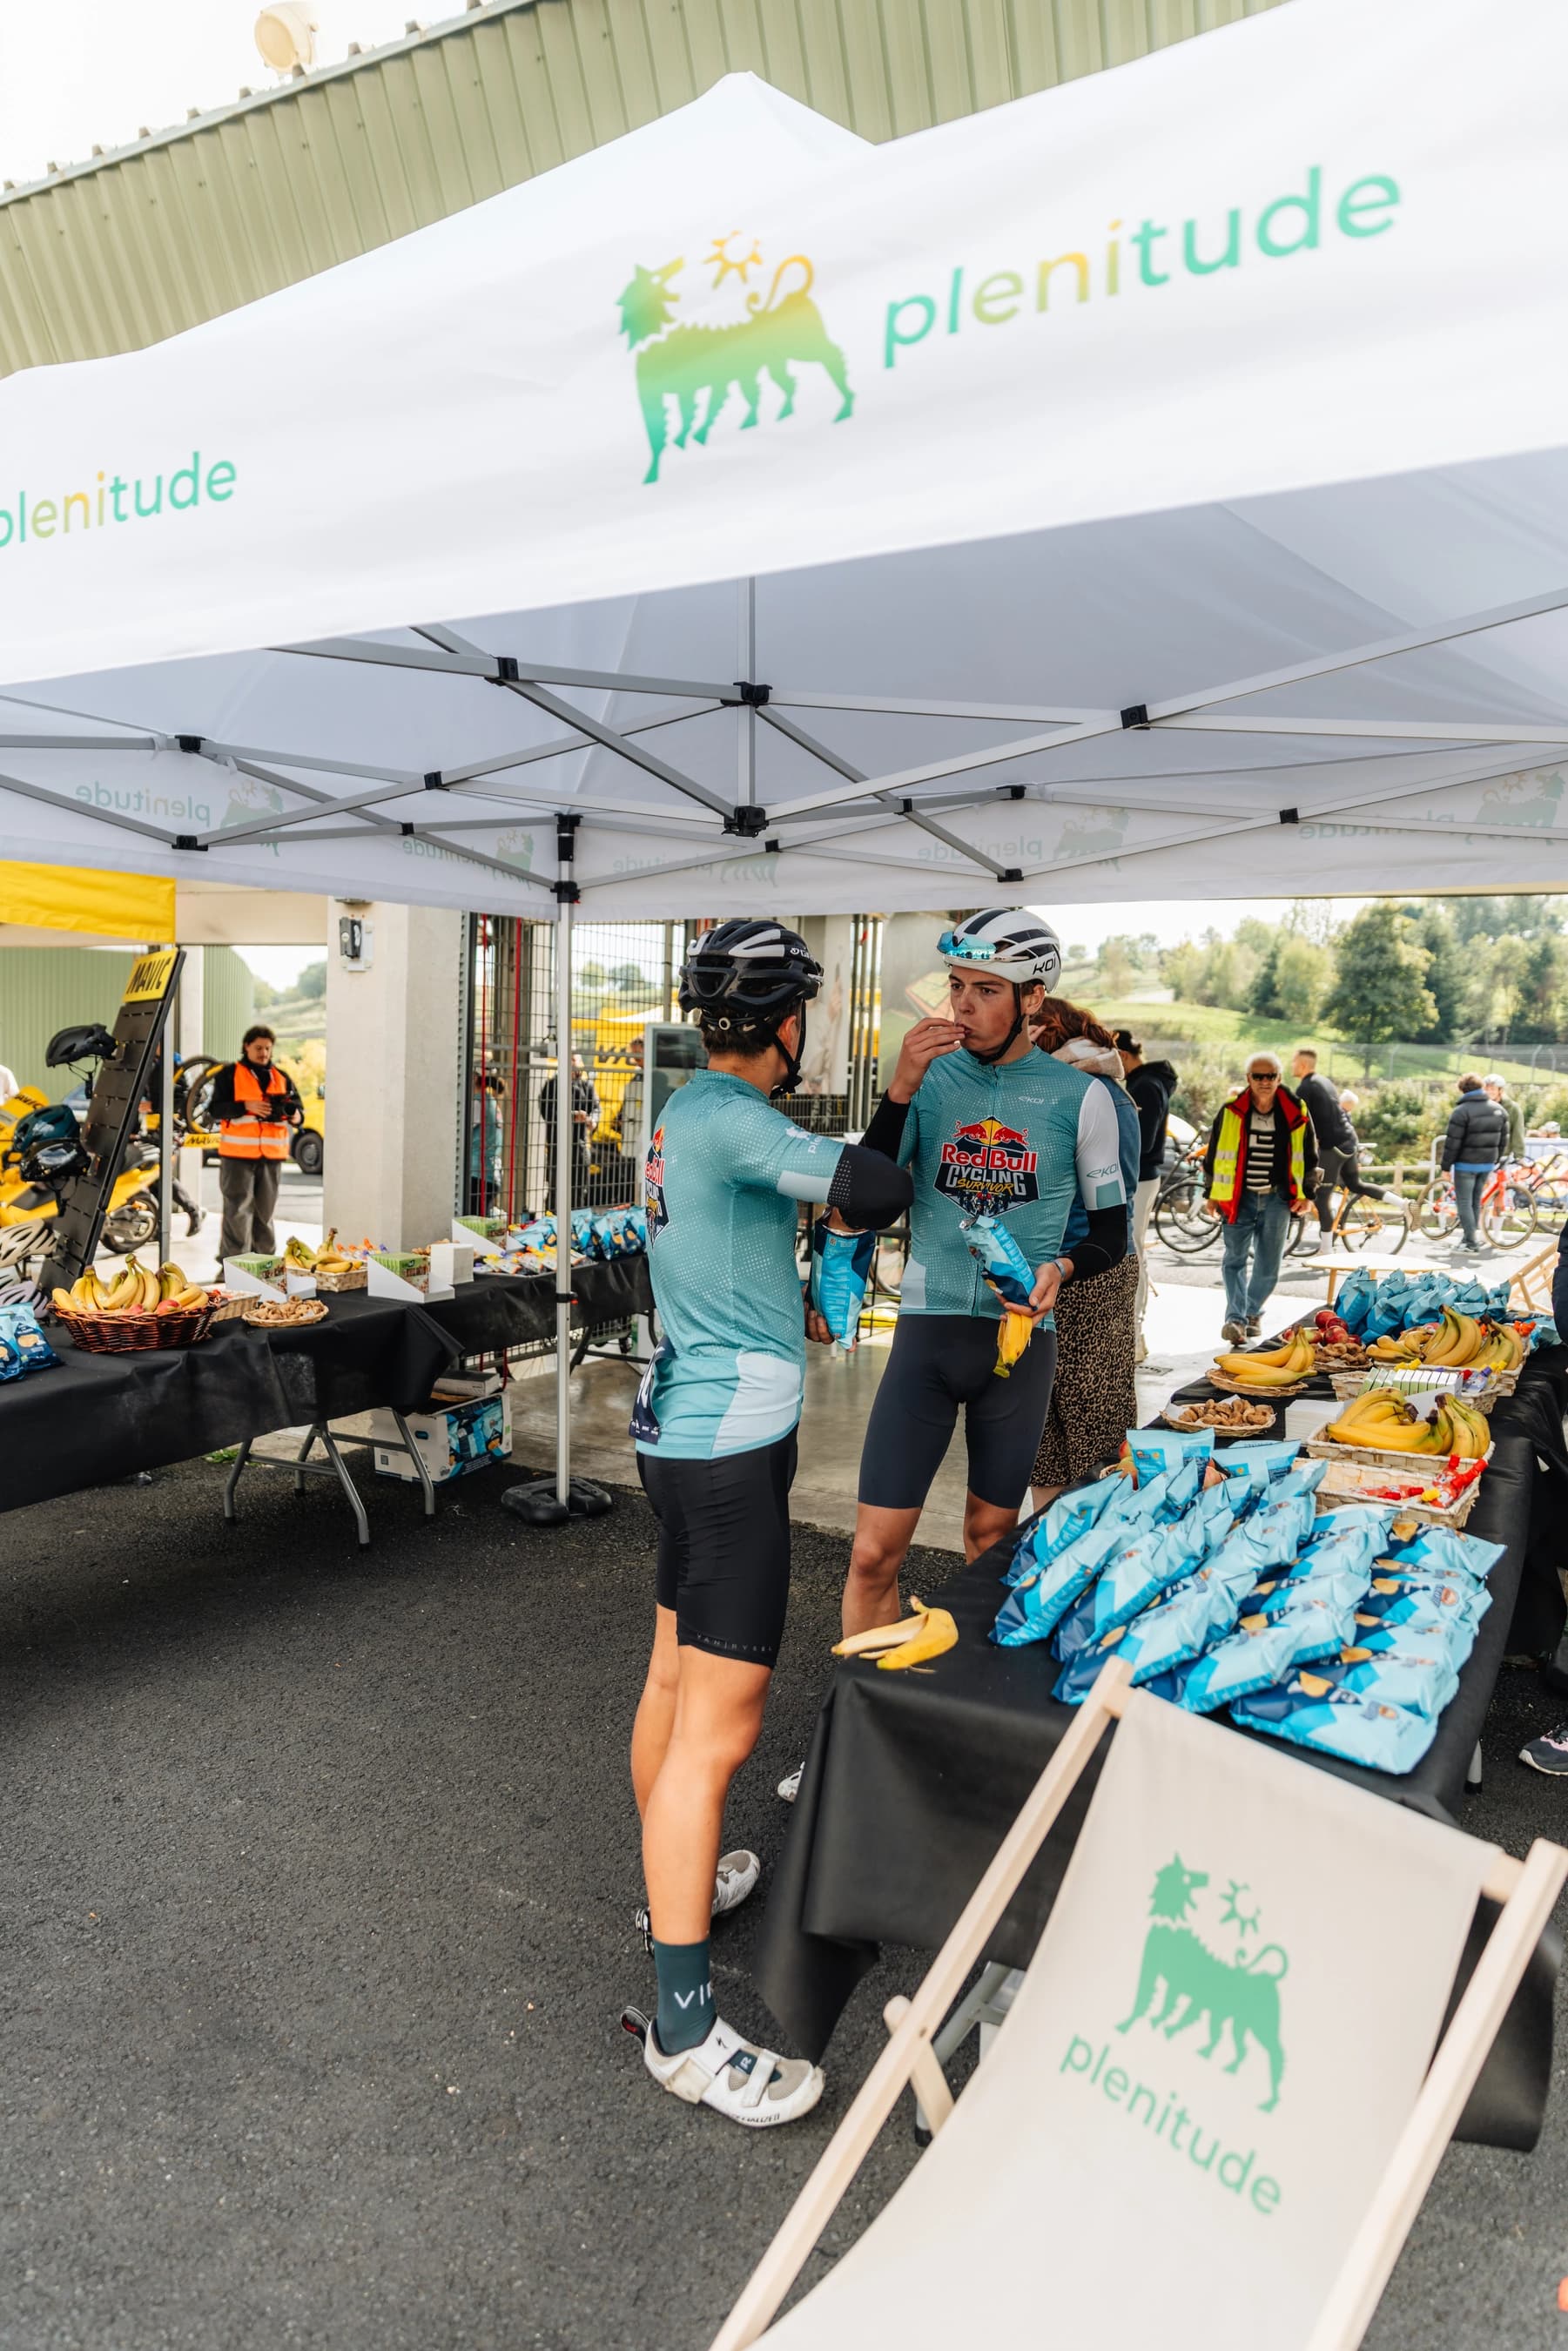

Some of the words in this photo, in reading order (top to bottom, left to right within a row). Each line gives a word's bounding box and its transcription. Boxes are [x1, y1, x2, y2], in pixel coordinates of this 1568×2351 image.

[883, 165, 1401, 370] plenitude
[126, 957, 172, 994] MAVIC
[941, 1142, 988, 1169] Red
[988, 1149, 1038, 1174] Bull
[946, 1165, 1027, 1196] CYCLING
[957, 1177, 1015, 1196] SURVIVOR
[1059, 2033, 1282, 2216] plenitude
